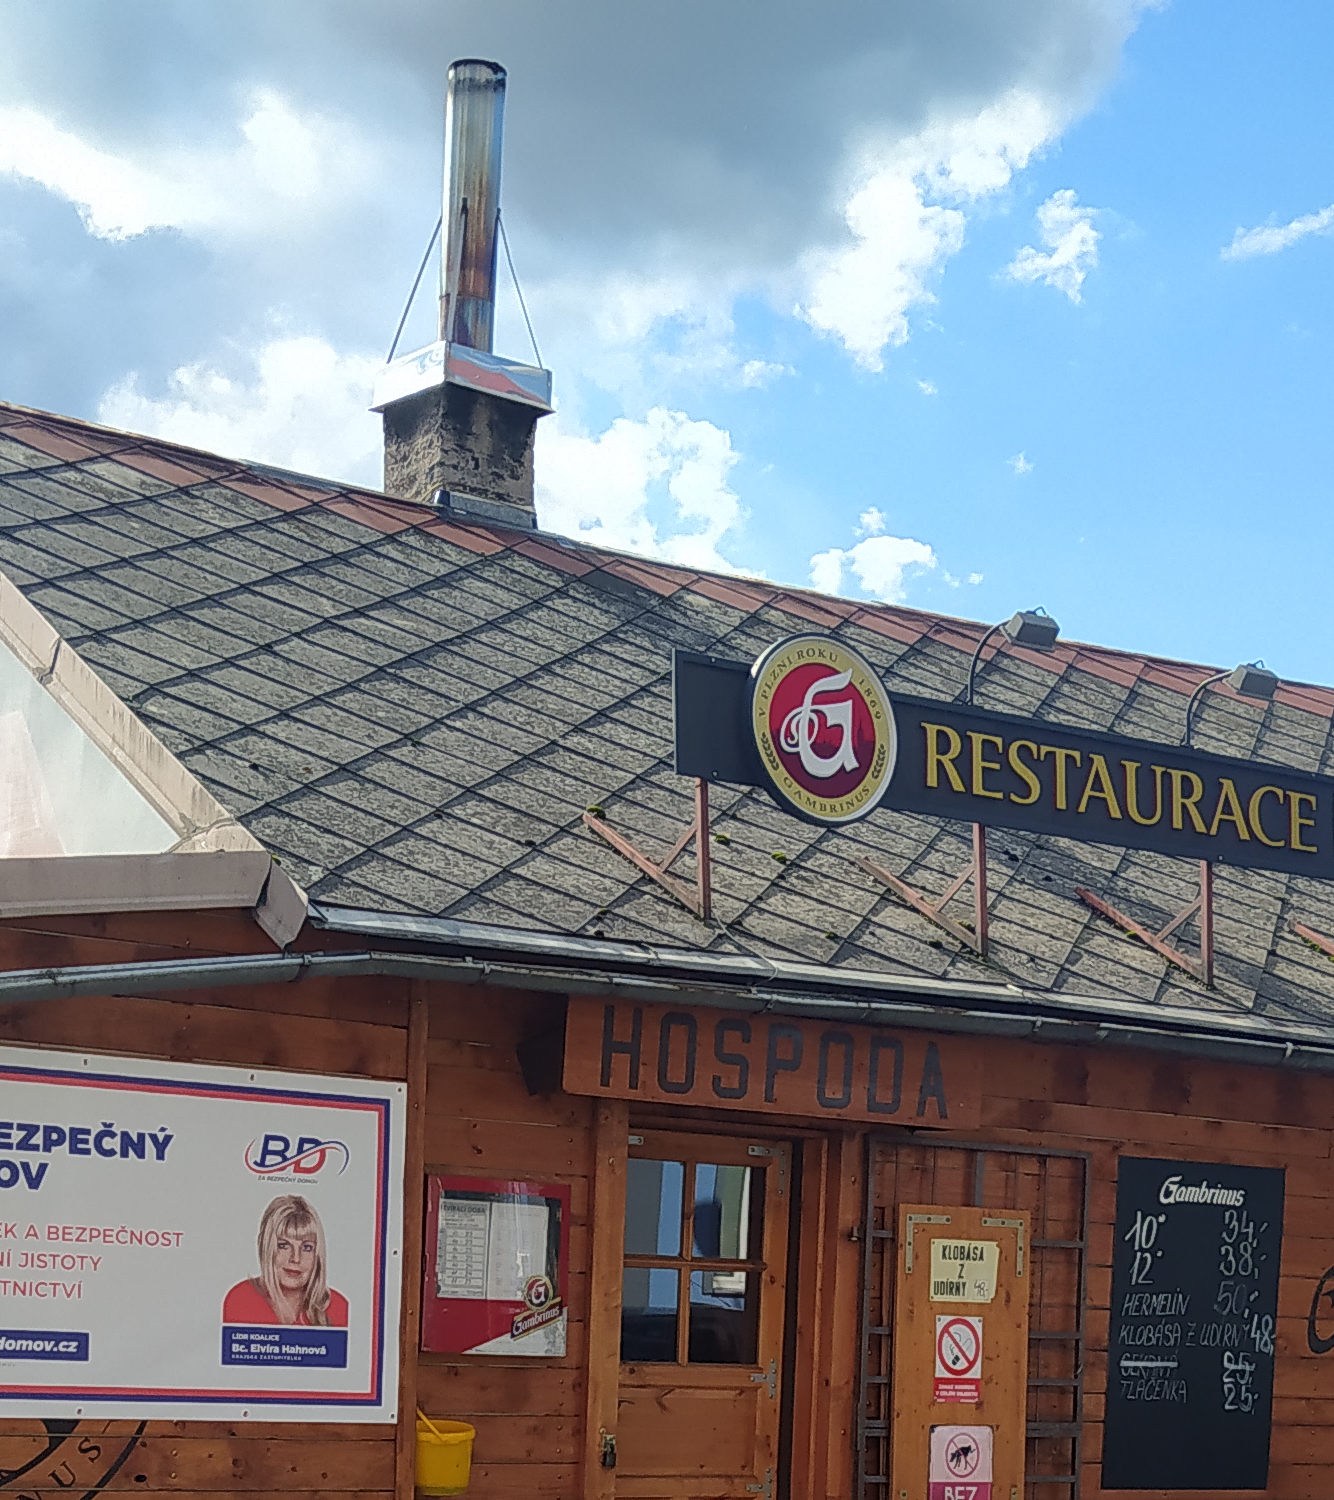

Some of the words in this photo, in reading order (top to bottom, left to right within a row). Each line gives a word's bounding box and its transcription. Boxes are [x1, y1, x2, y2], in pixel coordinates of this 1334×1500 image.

[758, 707, 767, 718] V
[797, 648, 838, 663] ROKU
[858, 678, 882, 720] 1869
[783, 776, 870, 813] GAMBRINUS
[920, 722, 1318, 853] RESTAURACE
[599, 1004, 948, 1119] HOSPODA
[1159, 1175, 1245, 1206] Gambrinus
[24, 1223, 40, 1240] A
[46, 1223, 184, 1248] BEZPEČNOST
[18, 1251, 102, 1272] JISTOTY
[941, 1243, 984, 1261] KLOBÁSA
[958, 1263, 965, 1279] Z
[933, 1278, 967, 1296] UDÍRNY
[1121, 1287, 1190, 1316] HERMELÍN
[512, 1305, 560, 1336] Gambrinus
[1118, 1318, 1181, 1346] KLOBÁSA
[231, 1343, 249, 1353] Bc.
[250, 1343, 280, 1354] Elvíra
[282, 1345, 327, 1355] Hahnová
[1120, 1377, 1187, 1403] TLAČENKA
